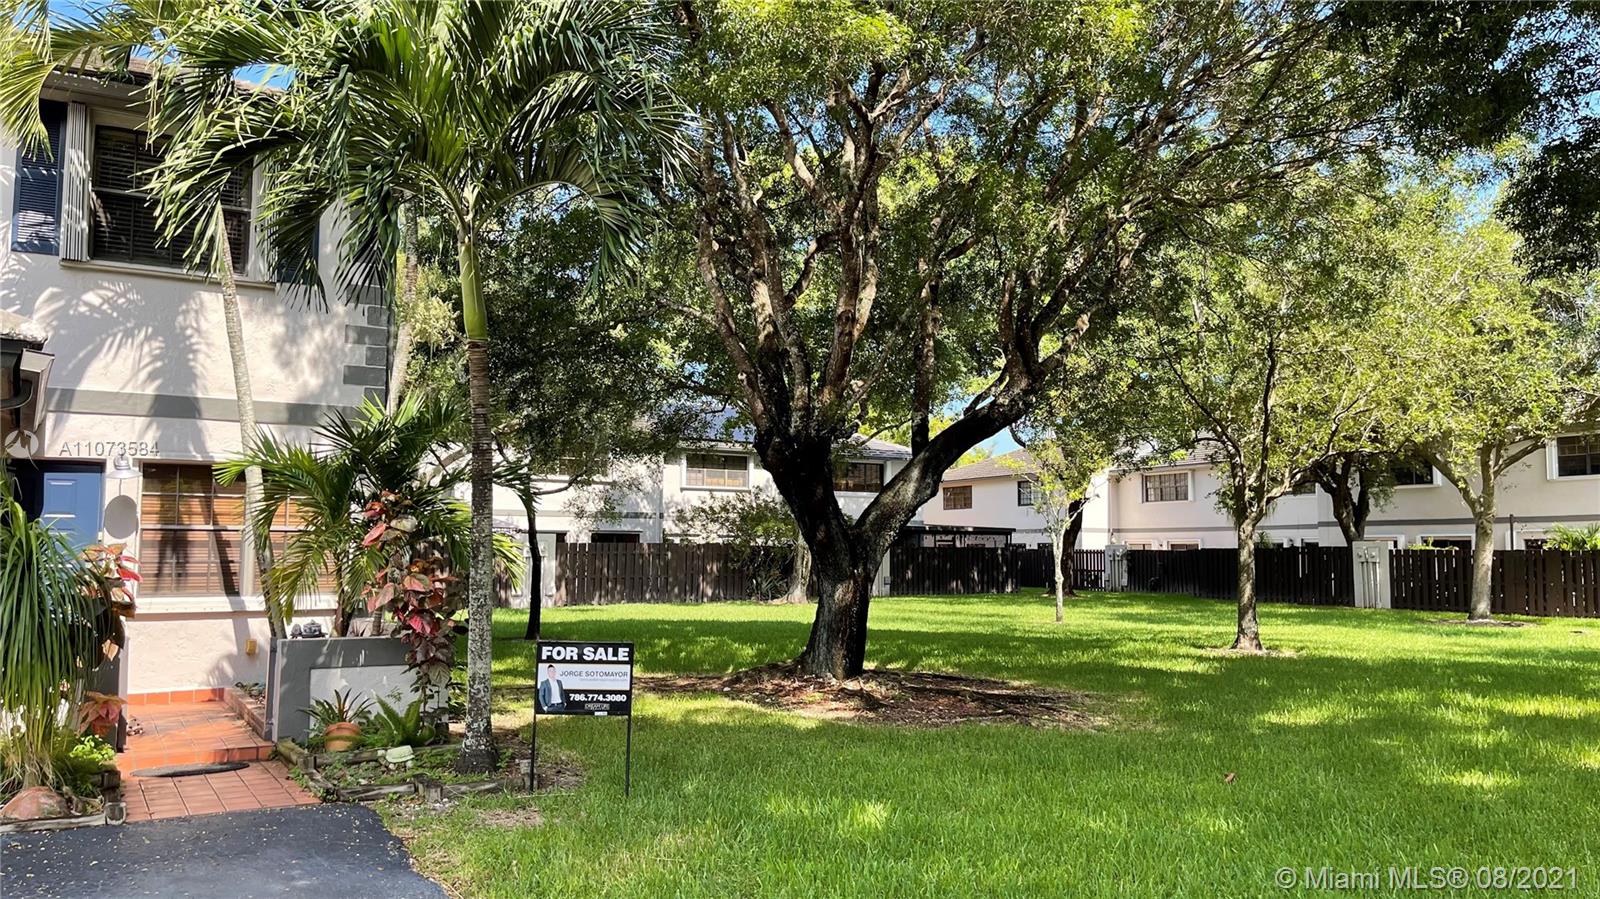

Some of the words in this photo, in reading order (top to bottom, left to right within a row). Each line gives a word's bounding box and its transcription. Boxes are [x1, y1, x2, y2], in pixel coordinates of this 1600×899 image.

[541, 646, 579, 660] FOR
[582, 647, 630, 661] SALE
[585, 670, 628, 678] SOTOMAYOR
